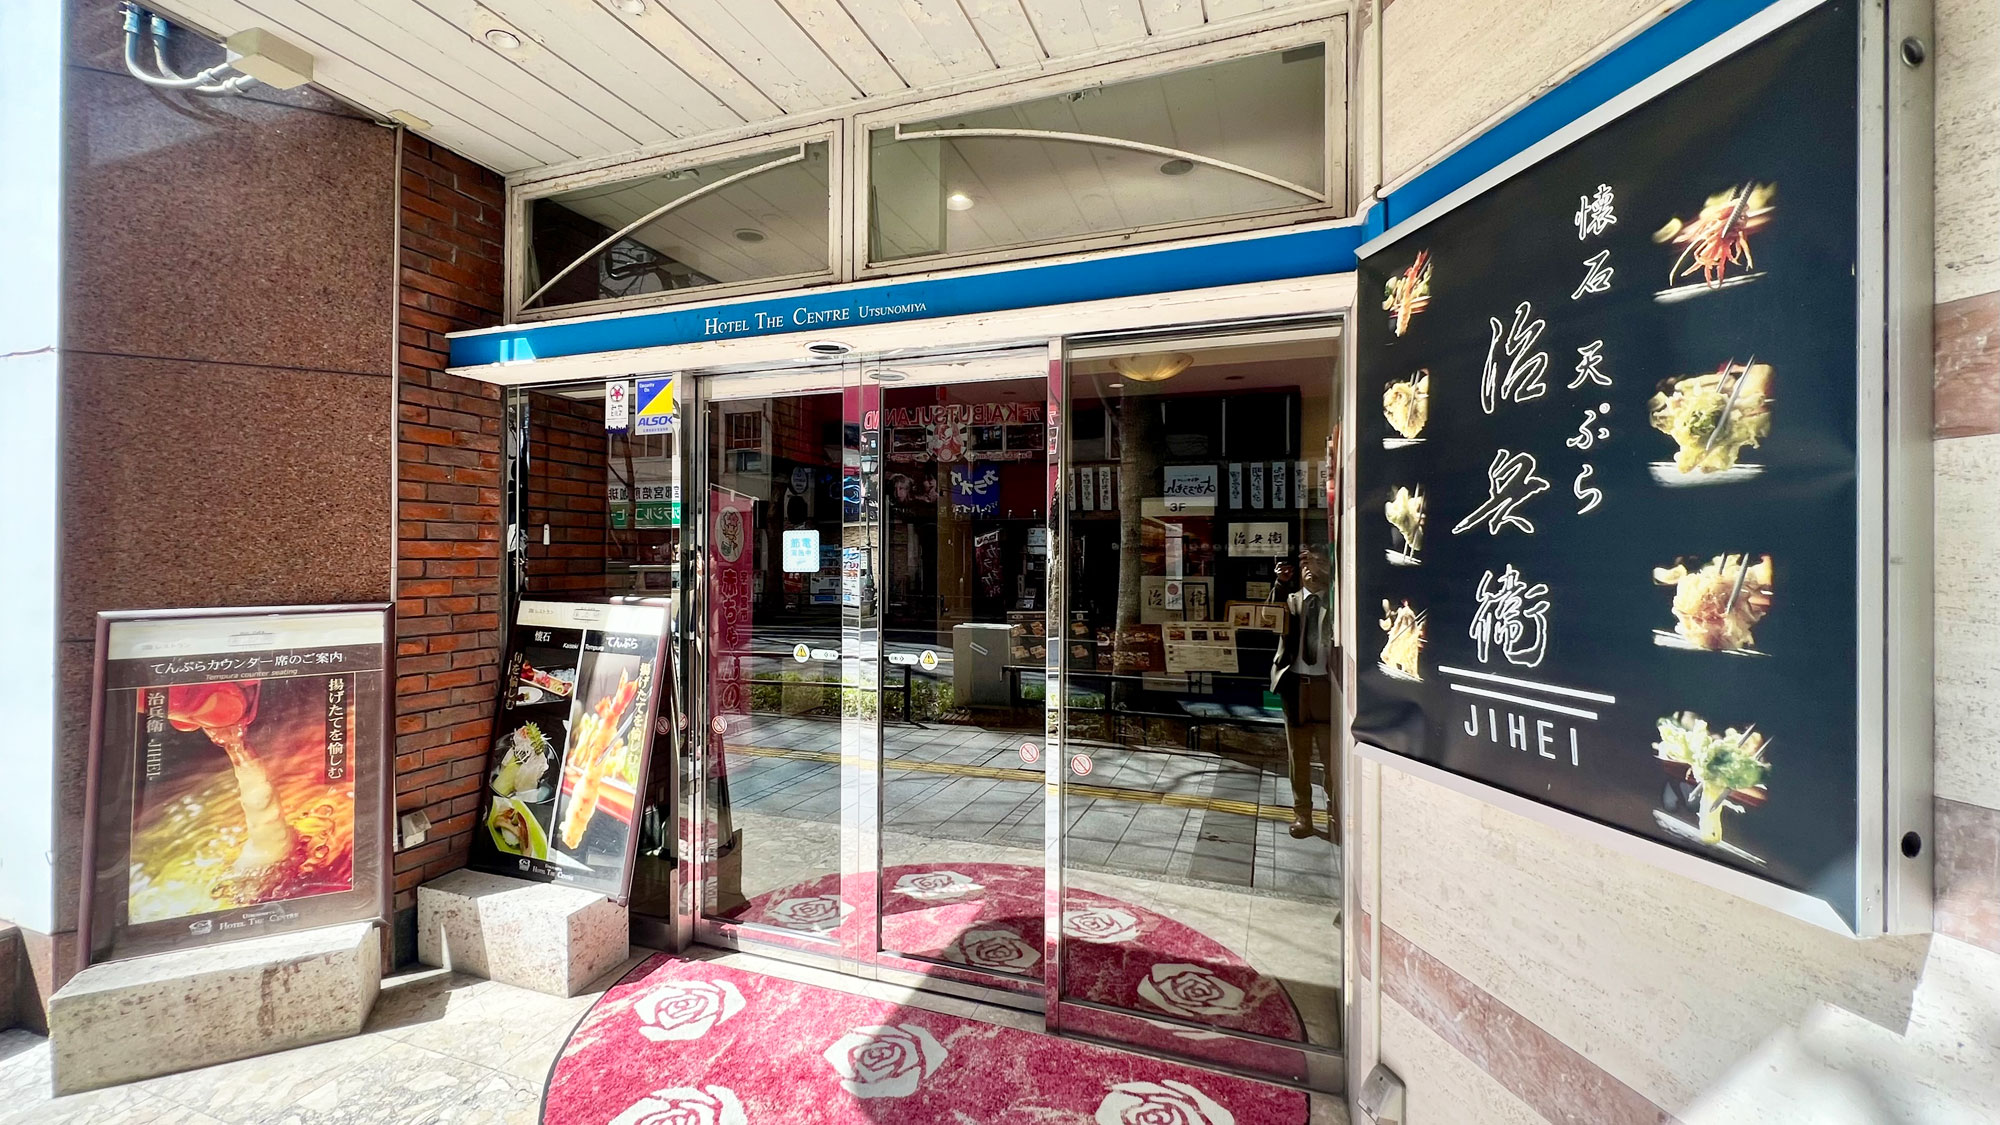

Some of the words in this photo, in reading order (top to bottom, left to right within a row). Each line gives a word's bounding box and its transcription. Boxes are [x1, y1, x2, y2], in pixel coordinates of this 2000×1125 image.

[1567, 340, 1612, 515] 天ぷら
[1170, 503, 1186, 512] 3F
[150, 651, 343, 676] てんぷらカウンター席のご案内
[606, 636, 638, 649] てんぷら
[146, 691, 165, 733] 治兵衛
[327, 678, 345, 780] 揚げたてを愉しむ
[1464, 705, 1580, 767] JIHEI
